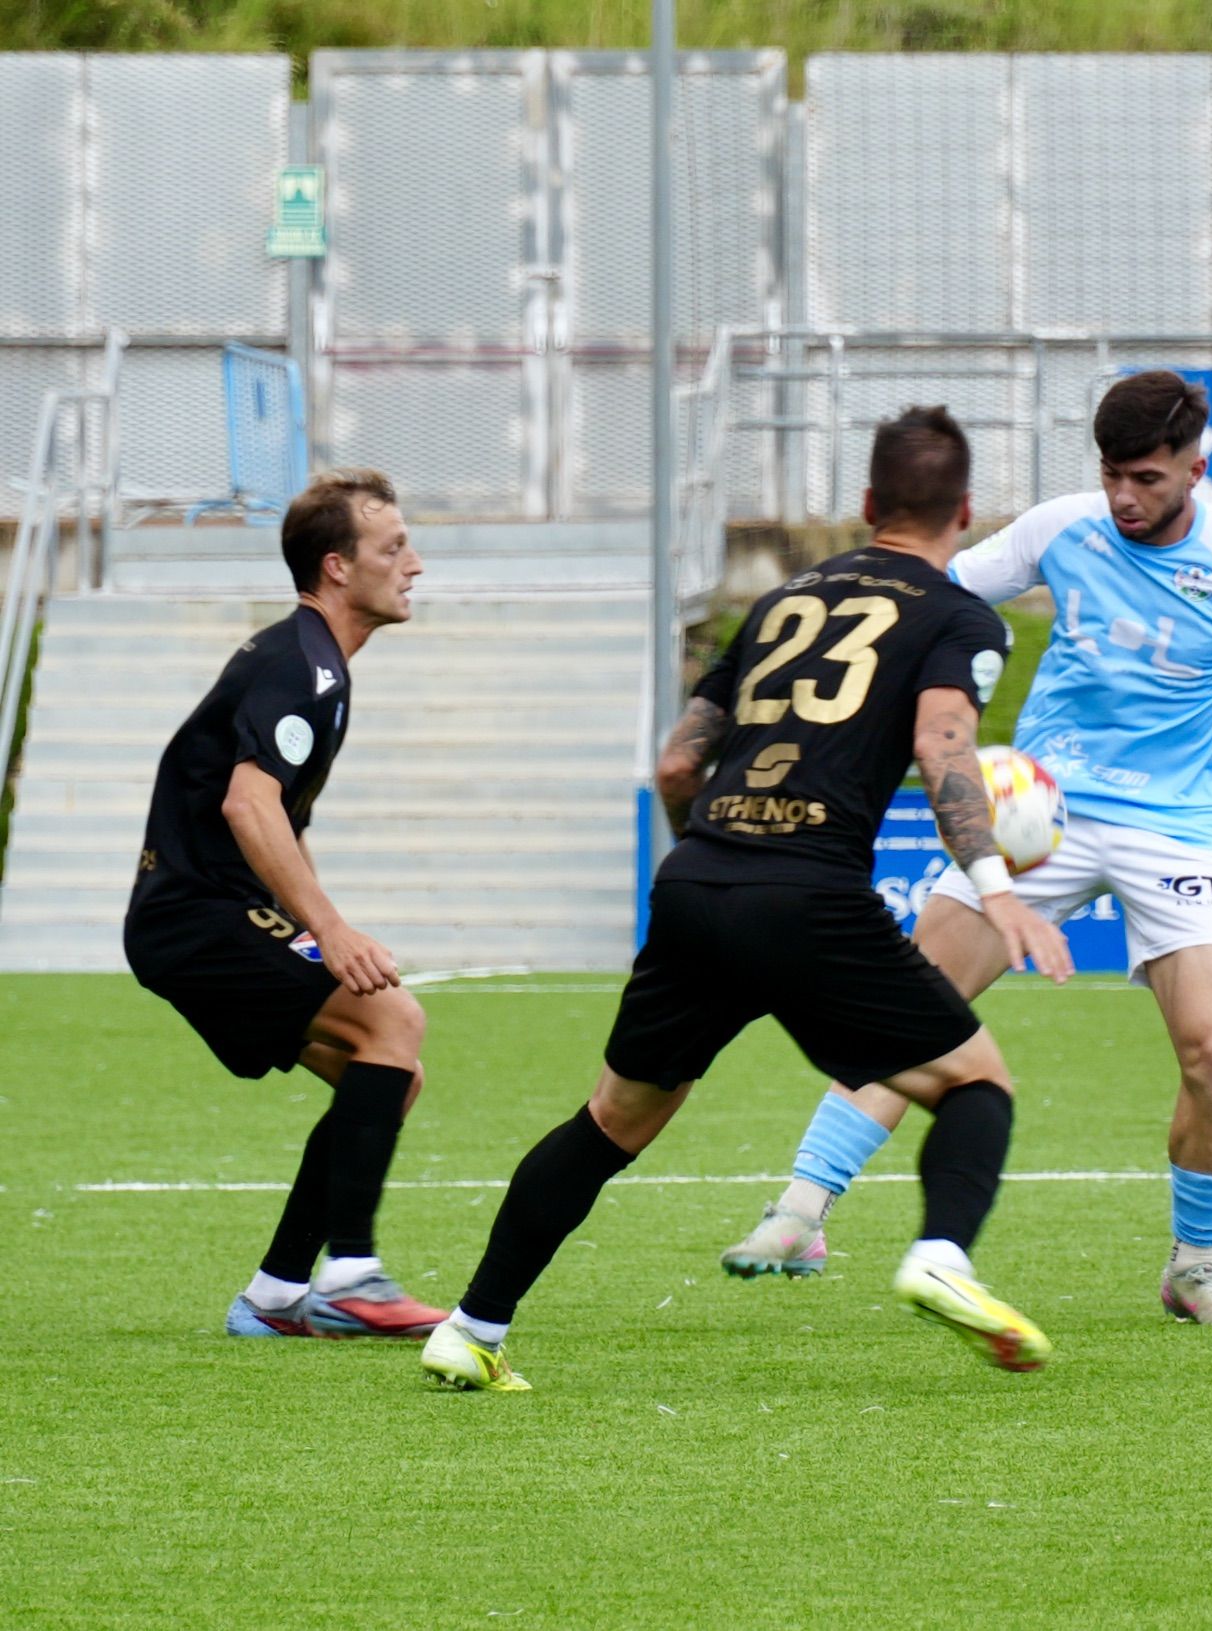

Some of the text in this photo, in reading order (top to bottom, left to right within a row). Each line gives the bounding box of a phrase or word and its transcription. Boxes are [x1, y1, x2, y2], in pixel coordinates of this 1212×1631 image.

[734, 594, 899, 726] 23
[707, 795, 828, 825] STHENOS
[247, 907, 296, 939] 9
